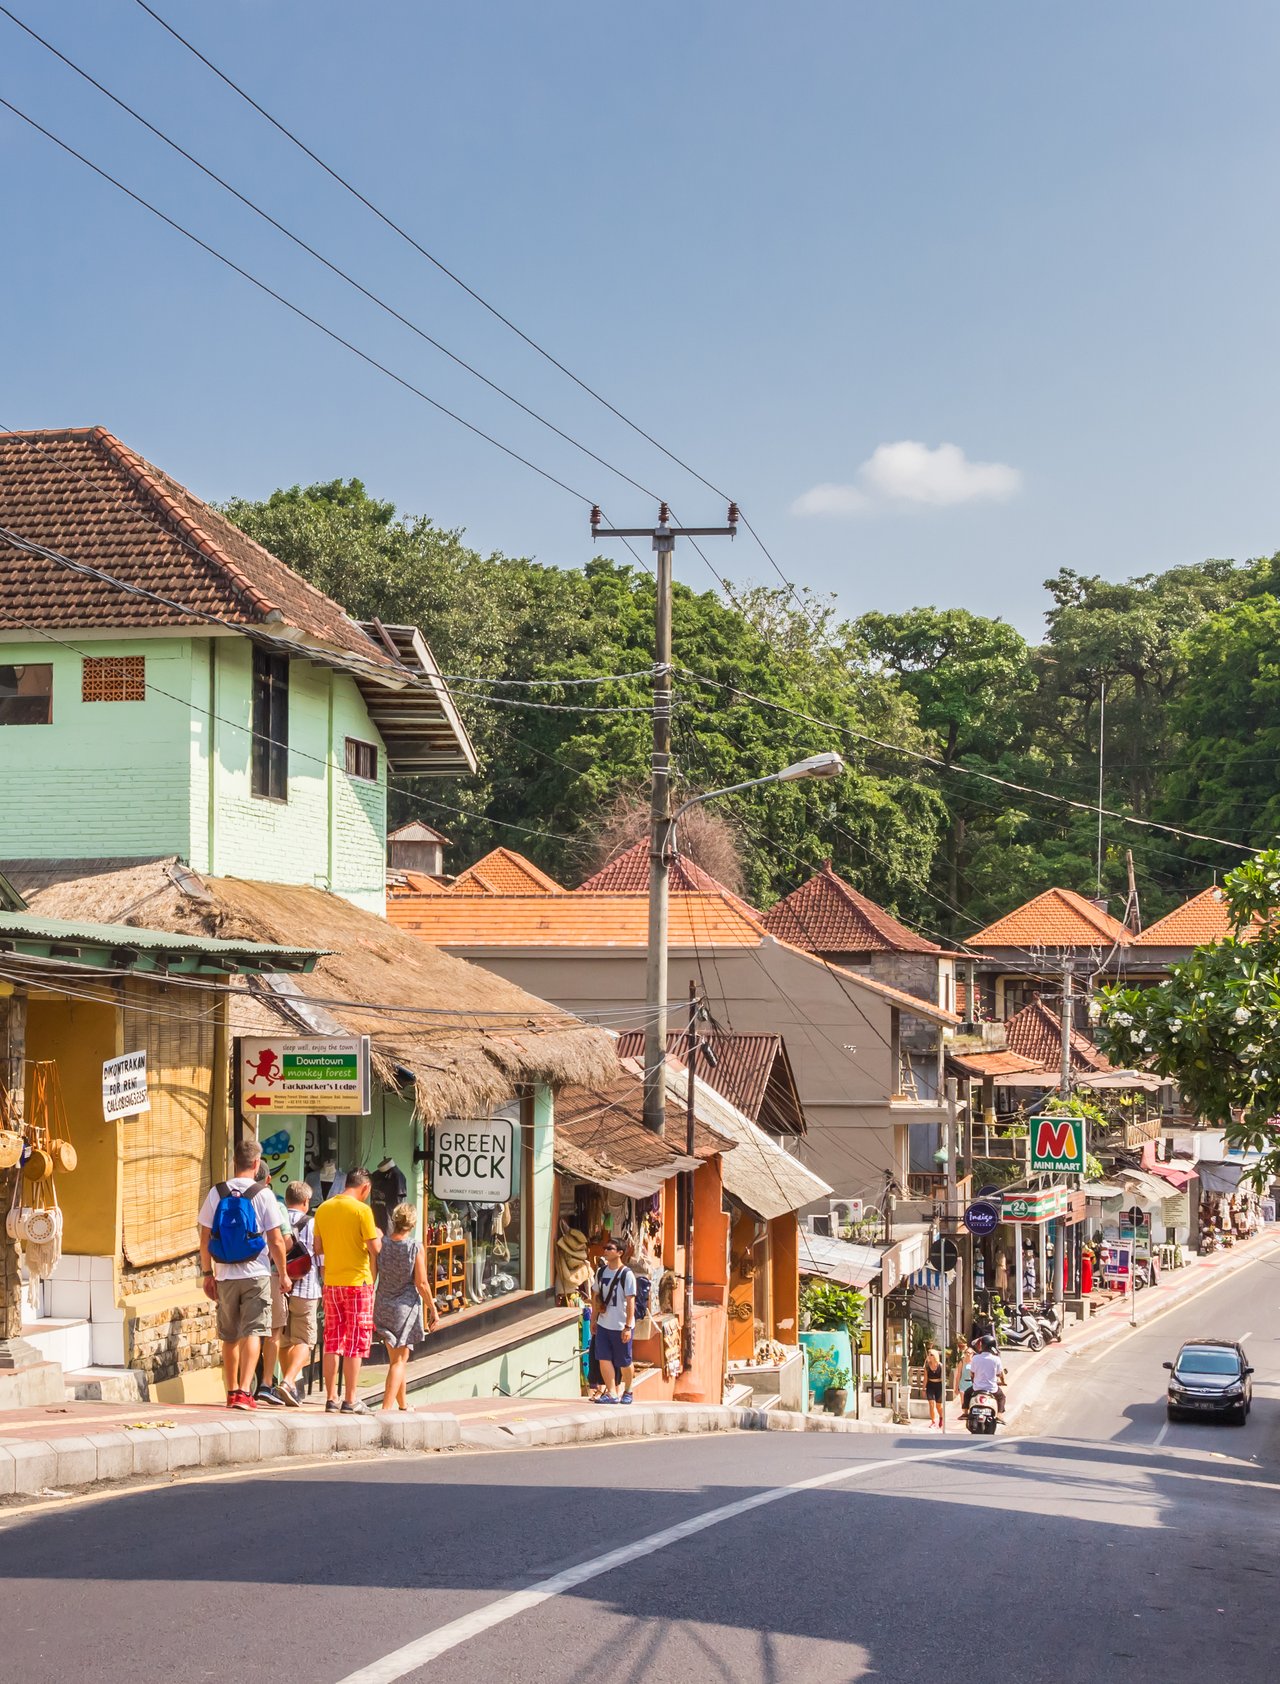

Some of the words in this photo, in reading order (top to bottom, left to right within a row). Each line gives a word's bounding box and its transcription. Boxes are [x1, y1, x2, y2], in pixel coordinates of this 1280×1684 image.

[282, 1044, 296, 1052] sleep
[296, 1056, 344, 1065] Downtown
[104, 1055, 146, 1080] DIKONTRAKAN
[287, 1069, 323, 1079] monkey
[325, 1068, 352, 1077] forest
[109, 1082, 121, 1096] FOR
[123, 1076, 138, 1091] RENT
[440, 1132, 506, 1153] GREEN
[439, 1153, 506, 1179] ROCK
[1033, 1161, 1054, 1170] MINI
[1055, 1162, 1081, 1171] MART
[1013, 1202, 1026, 1211] 24
